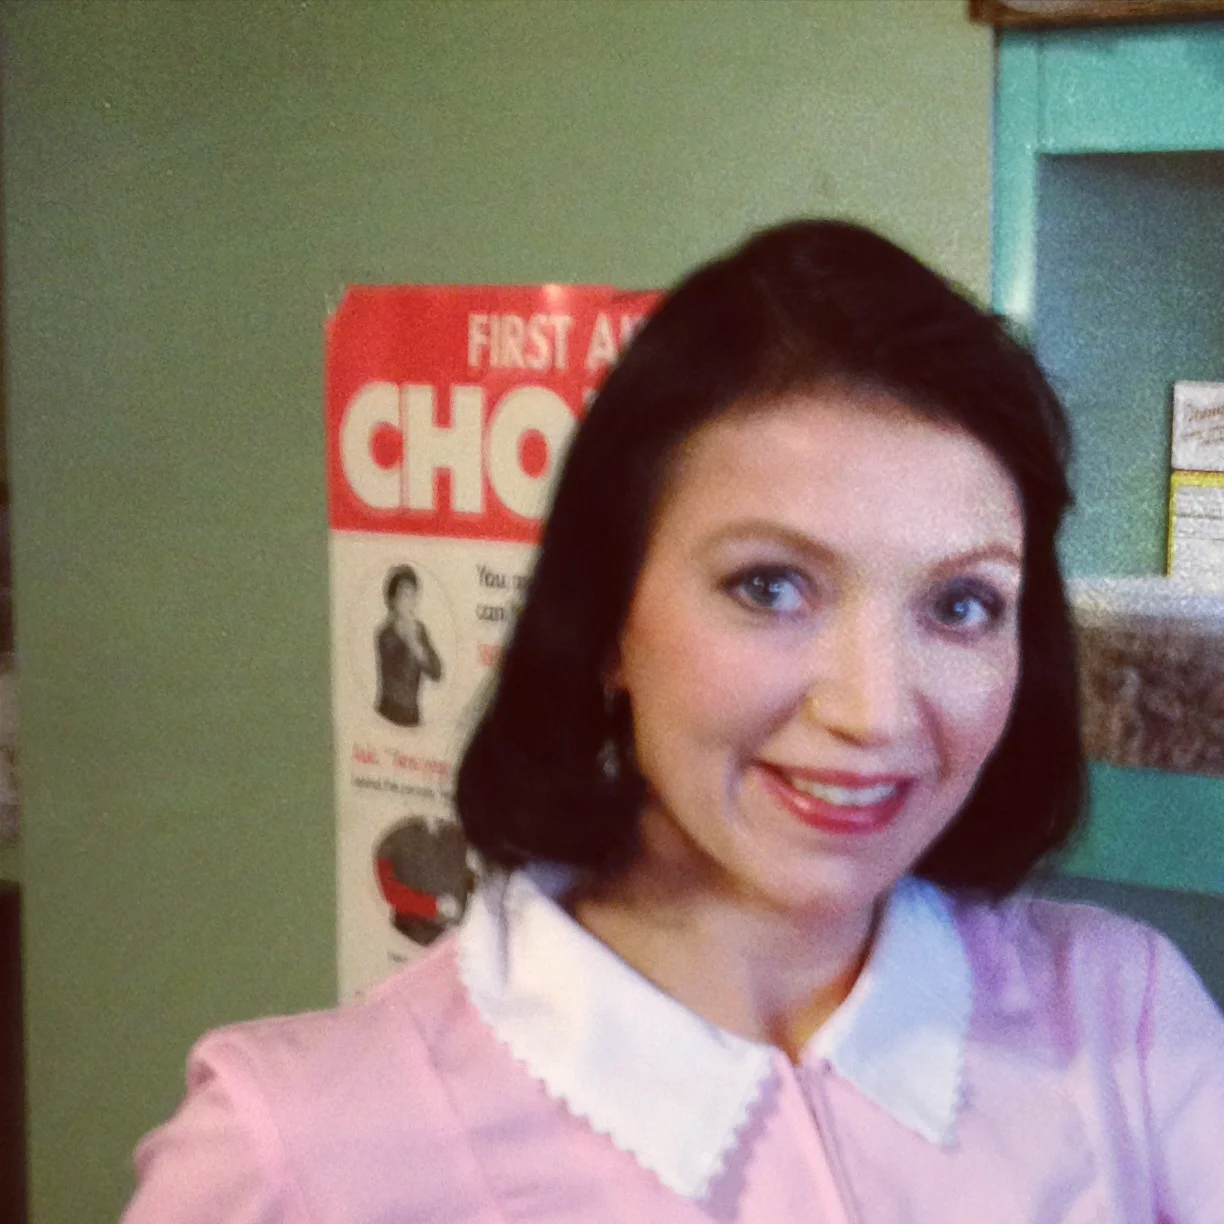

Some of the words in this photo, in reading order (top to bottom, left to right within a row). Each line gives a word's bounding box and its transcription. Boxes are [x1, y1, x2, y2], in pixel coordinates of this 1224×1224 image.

[467, 312, 573, 370] FIRST
[339, 380, 598, 521] CHO
[475, 563, 506, 590] You
